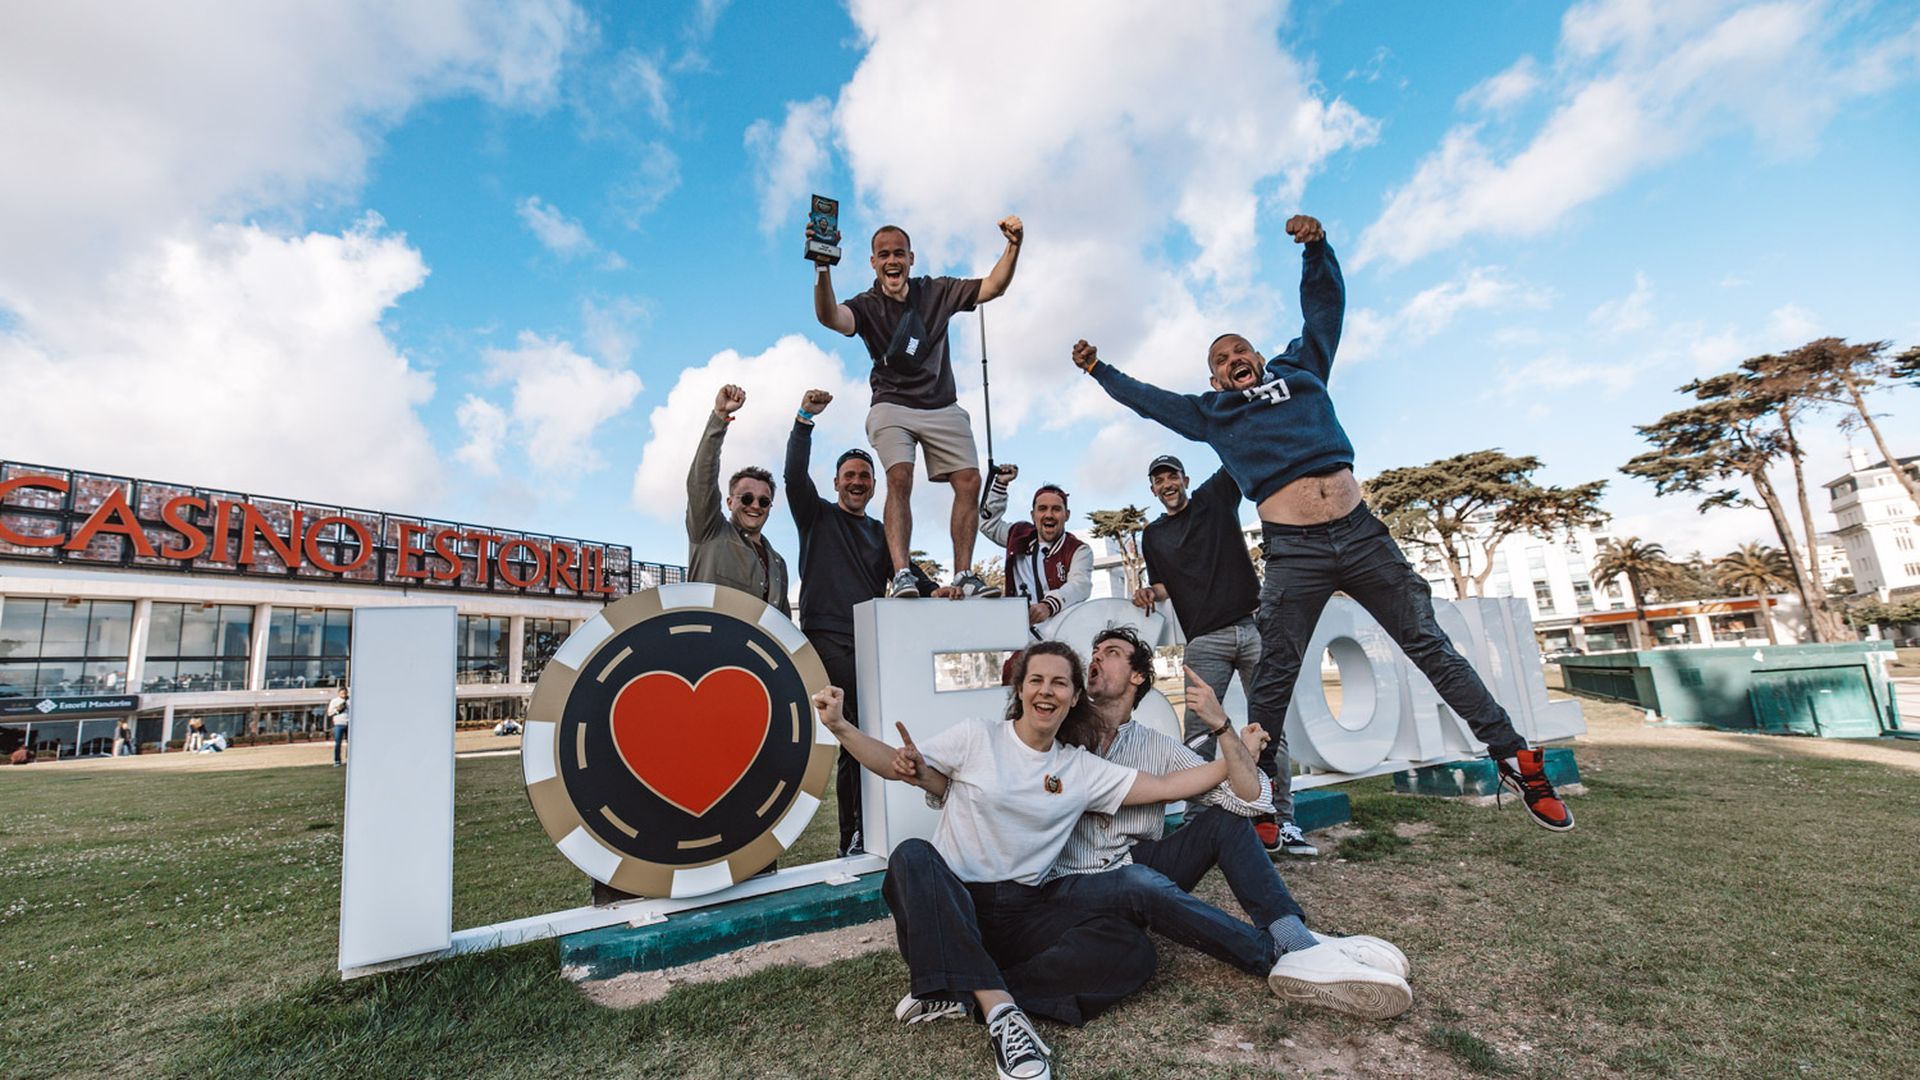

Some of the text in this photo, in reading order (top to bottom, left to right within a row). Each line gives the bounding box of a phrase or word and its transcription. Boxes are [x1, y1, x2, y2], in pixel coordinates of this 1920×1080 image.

[0, 476, 614, 593] CASINO ESTORIL
[59, 701, 87, 710] Estoril
[855, 596, 1587, 862] EORIL
